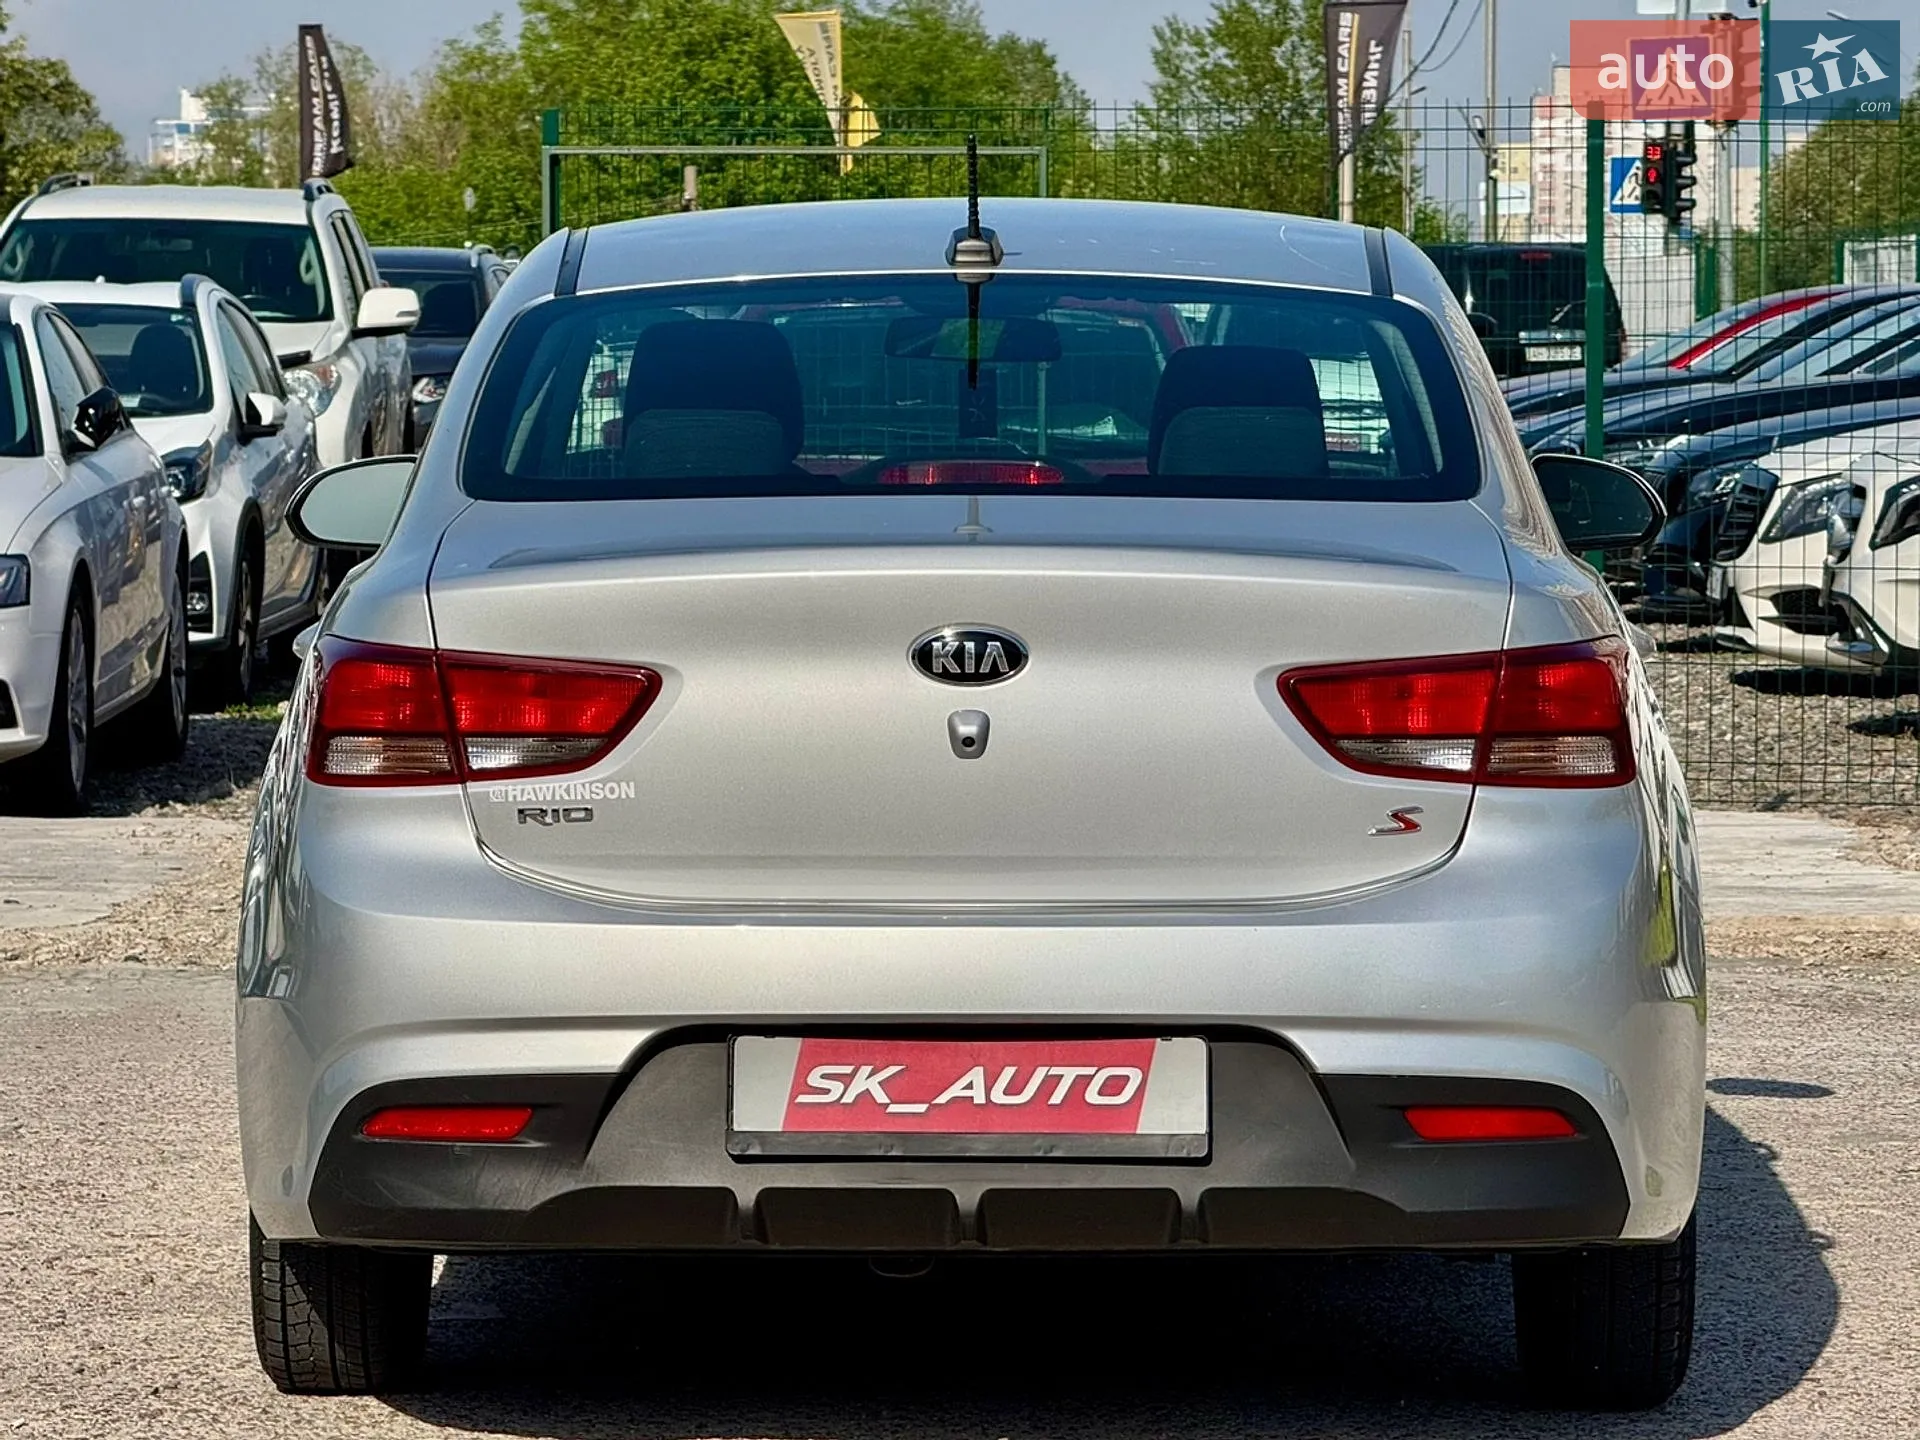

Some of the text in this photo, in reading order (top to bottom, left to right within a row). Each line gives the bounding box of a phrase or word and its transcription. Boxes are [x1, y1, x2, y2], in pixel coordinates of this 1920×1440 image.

[931, 641, 1009, 673] KIA
[517, 806, 594, 826] RIO
[1367, 806, 1424, 836] S
[795, 1064, 1144, 1114] SK_AUTO
